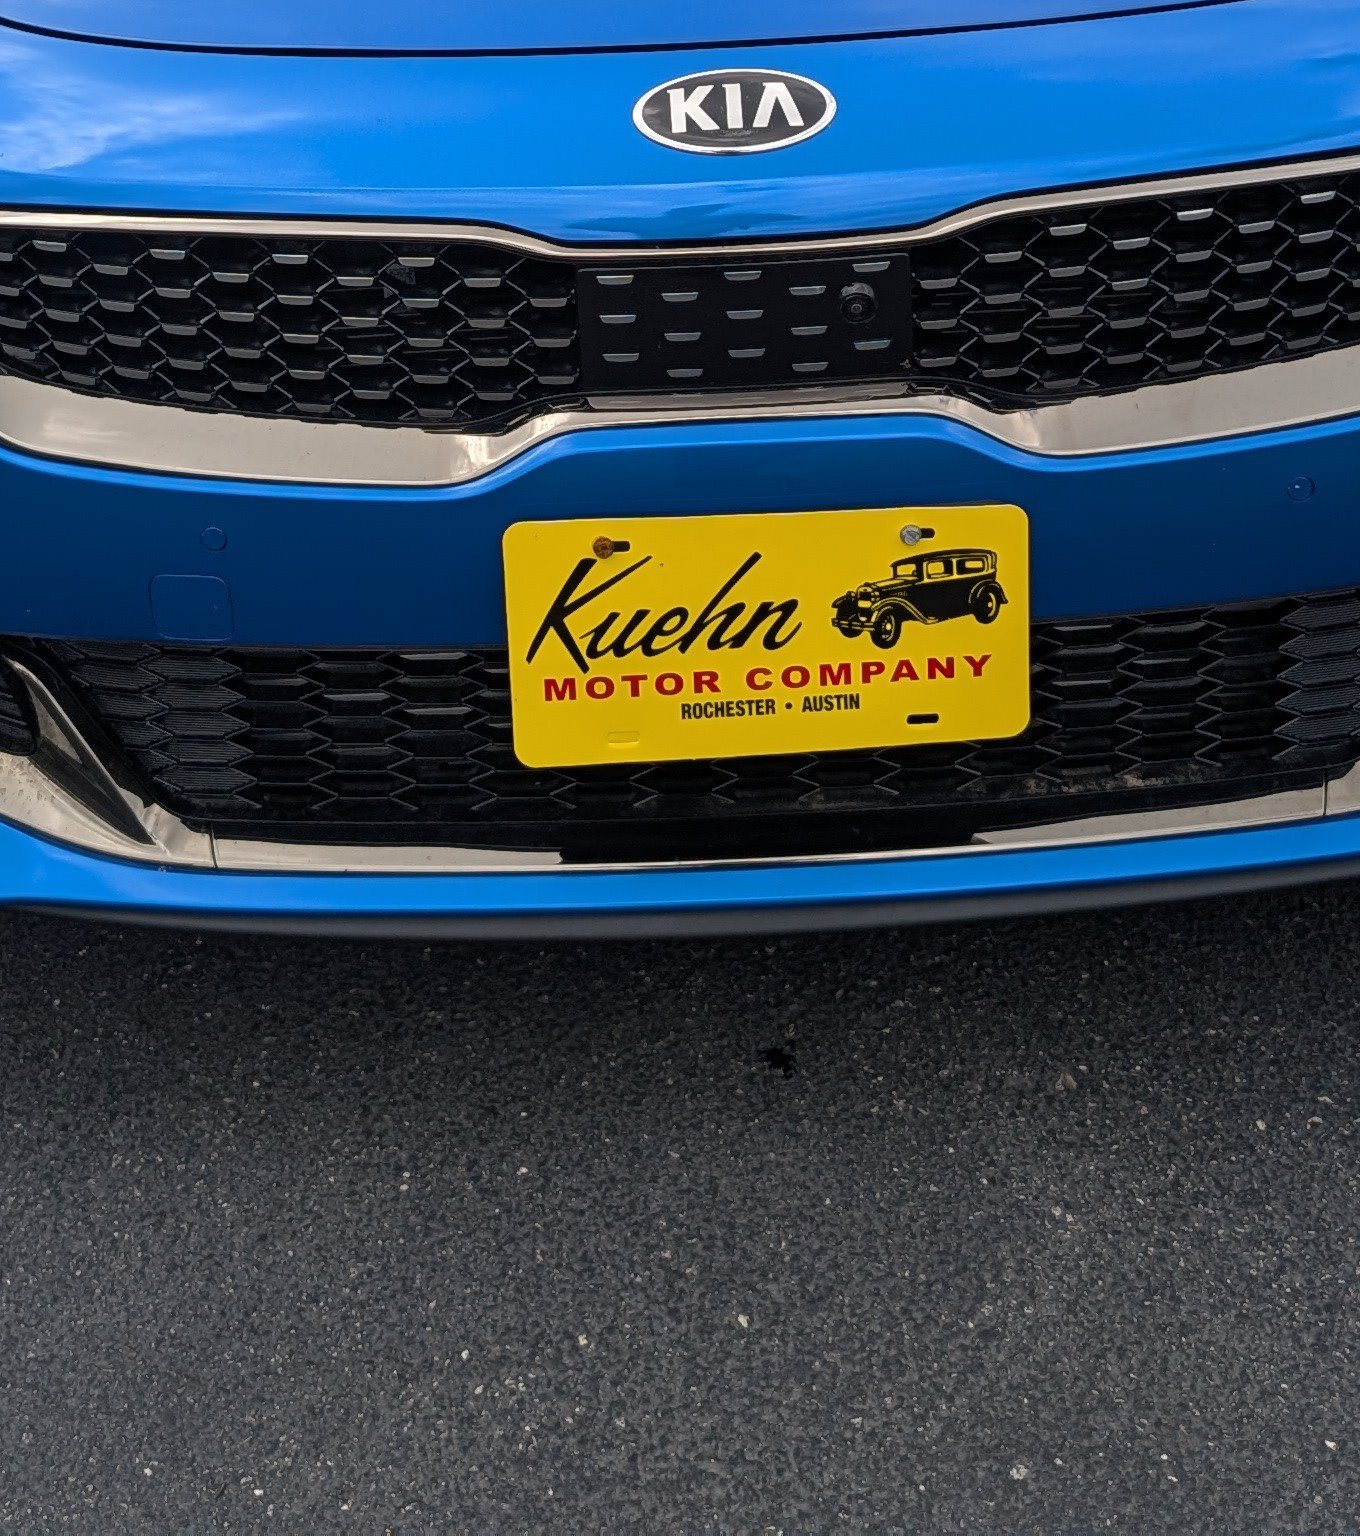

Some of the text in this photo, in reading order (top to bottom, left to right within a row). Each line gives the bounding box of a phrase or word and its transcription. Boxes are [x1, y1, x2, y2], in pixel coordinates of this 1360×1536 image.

[666, 81, 805, 134] KIA
[525, 551, 802, 674] Kuehn
[543, 653, 993, 702] MOTOR COMPANY
[680, 692, 861, 721] ROCHESTER AUSTIN
